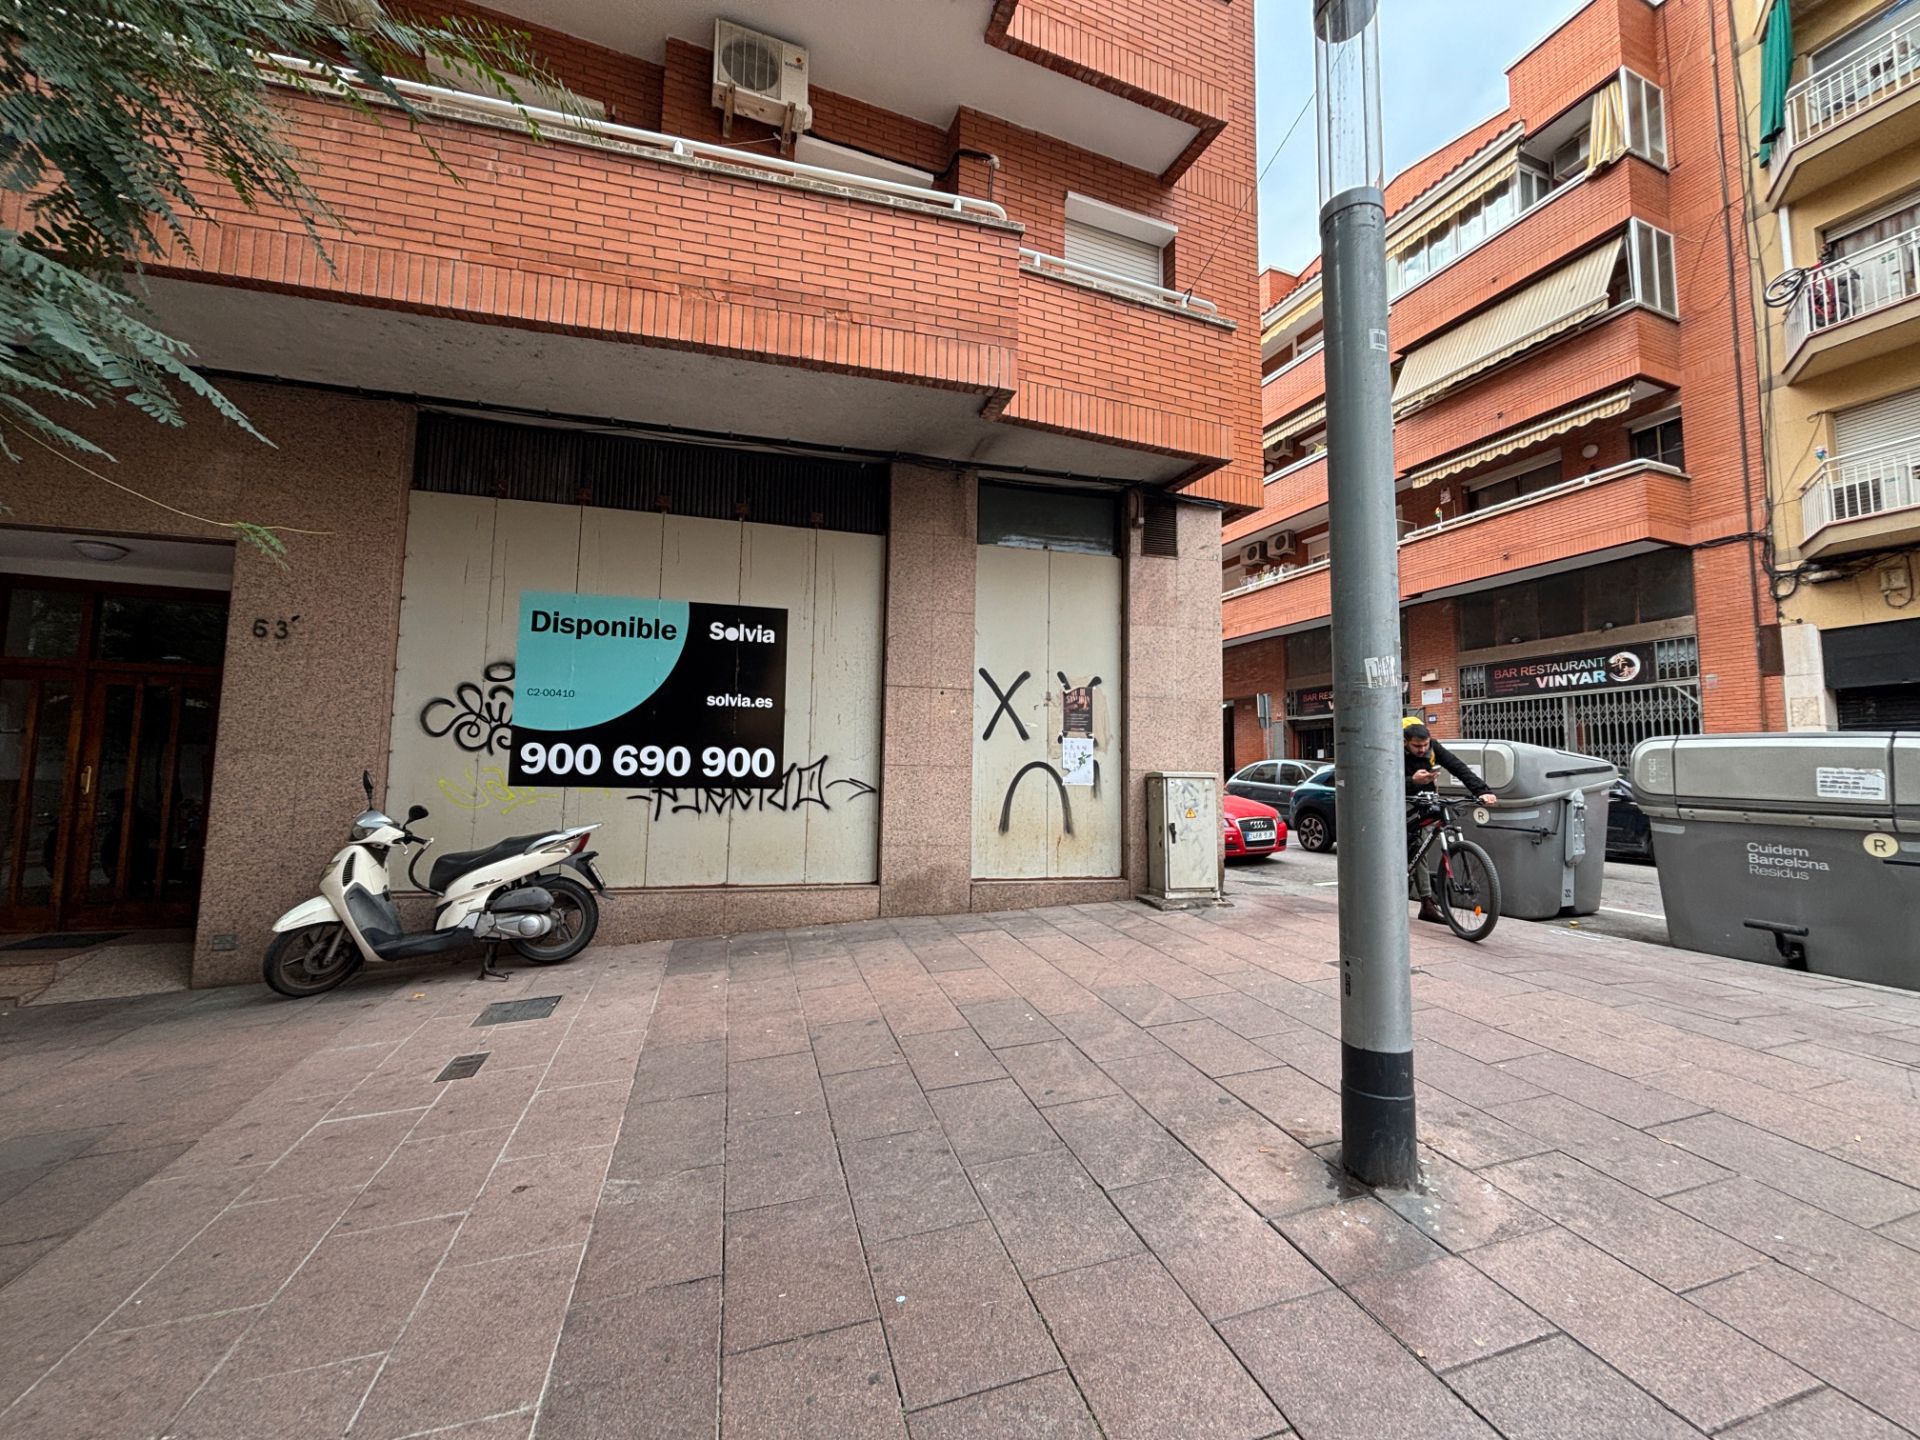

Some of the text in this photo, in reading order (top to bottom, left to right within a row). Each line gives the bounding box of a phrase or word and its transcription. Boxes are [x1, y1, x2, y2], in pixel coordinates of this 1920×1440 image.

[531, 610, 677, 640] Disponible
[709, 621, 775, 643] Solvia
[1494, 668, 1518, 679] BAR
[1520, 657, 1605, 676] RESTAURANT
[1536, 670, 1607, 688] VINYAR
[527, 687, 575, 697] C2-00410
[706, 693, 773, 708] solvia.es
[1303, 692, 1318, 702] BAR
[520, 742, 775, 778] 900 690 900
[1746, 842, 1809, 857] Cuidem
[1873, 839, 1887, 853] R
[1748, 853, 1830, 871] Barcelona
[1749, 864, 1809, 880] Residus
